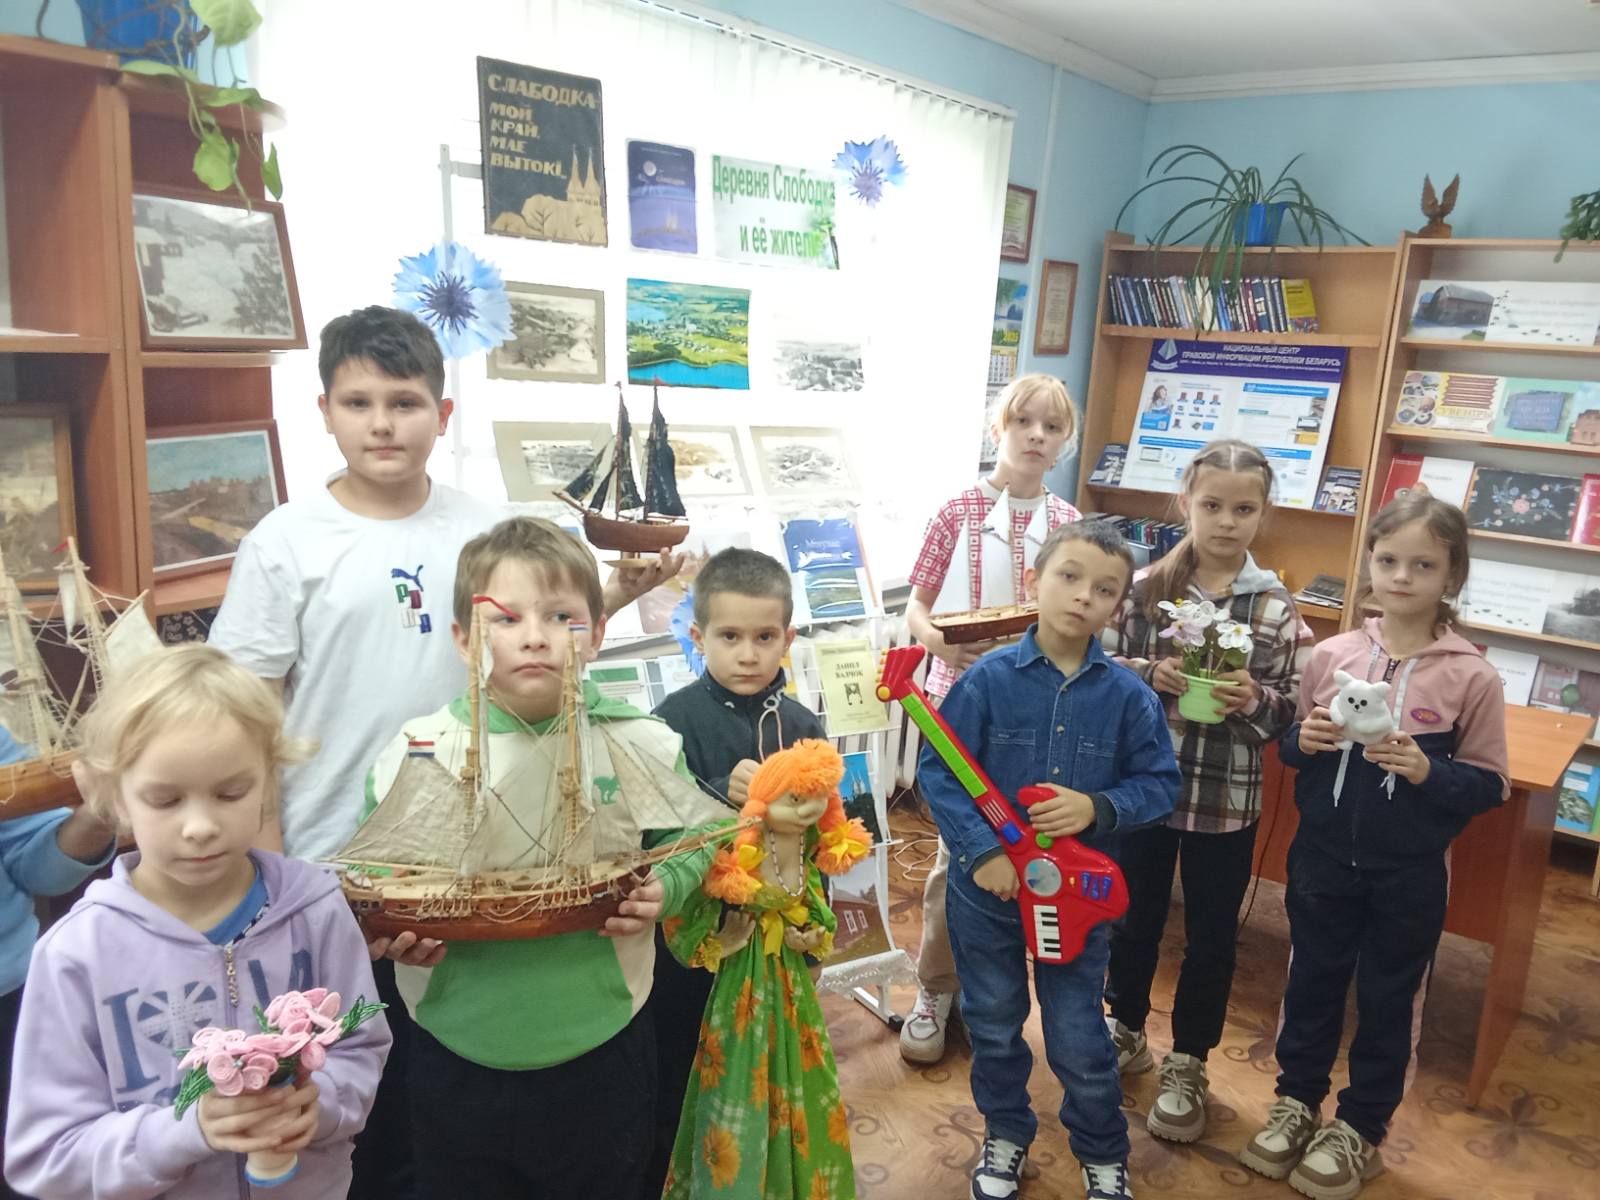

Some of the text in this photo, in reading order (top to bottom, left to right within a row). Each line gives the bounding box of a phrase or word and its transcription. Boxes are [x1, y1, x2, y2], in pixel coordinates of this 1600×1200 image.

[488, 74, 597, 109] СЛАБОДКА
[489, 102, 533, 120] МОЙ
[489, 135, 528, 153] МАЕ
[712, 155, 836, 217] Деревня Слободка
[739, 225, 749, 252] и
[752, 216, 768, 254] её
[1278, 346, 1301, 355] ЦЕНТР
